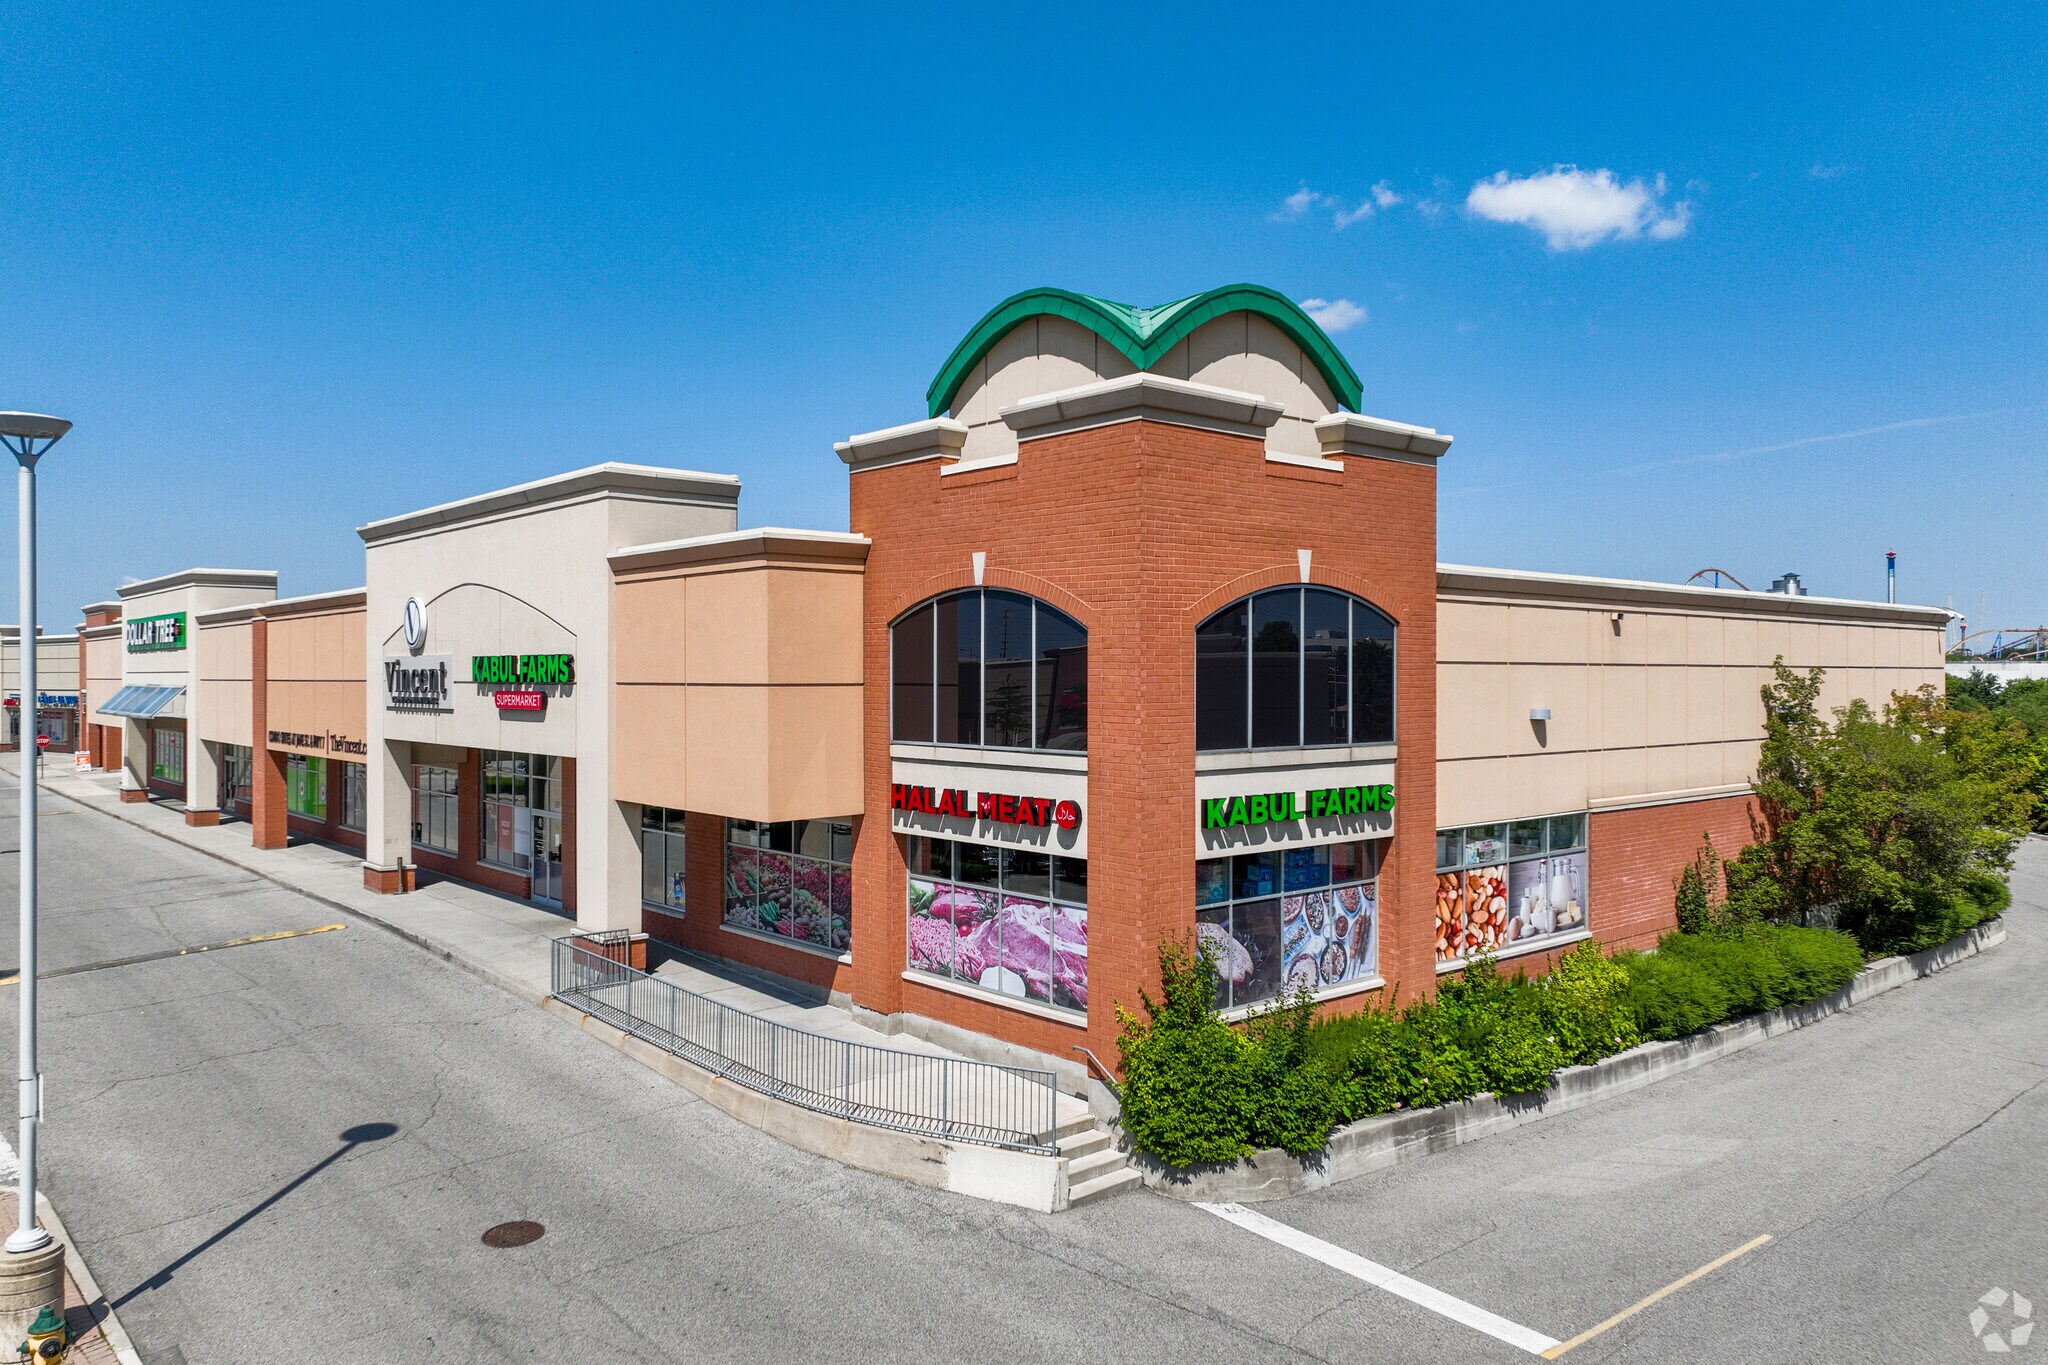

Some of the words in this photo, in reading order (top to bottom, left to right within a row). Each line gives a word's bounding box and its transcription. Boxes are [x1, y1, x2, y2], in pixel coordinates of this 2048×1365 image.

[126, 621, 152, 646] DOLLAR
[155, 618, 174, 643] TREE
[384, 659, 447, 694] Vincent
[472, 655, 517, 683] KABUL
[519, 654, 570, 683] FARMS
[496, 694, 541, 708] SUPERMARKET
[891, 783, 971, 818] HALAL
[977, 791, 1051, 827] MEAT
[1204, 792, 1304, 829] KABUL
[1311, 783, 1395, 818] FARMS
